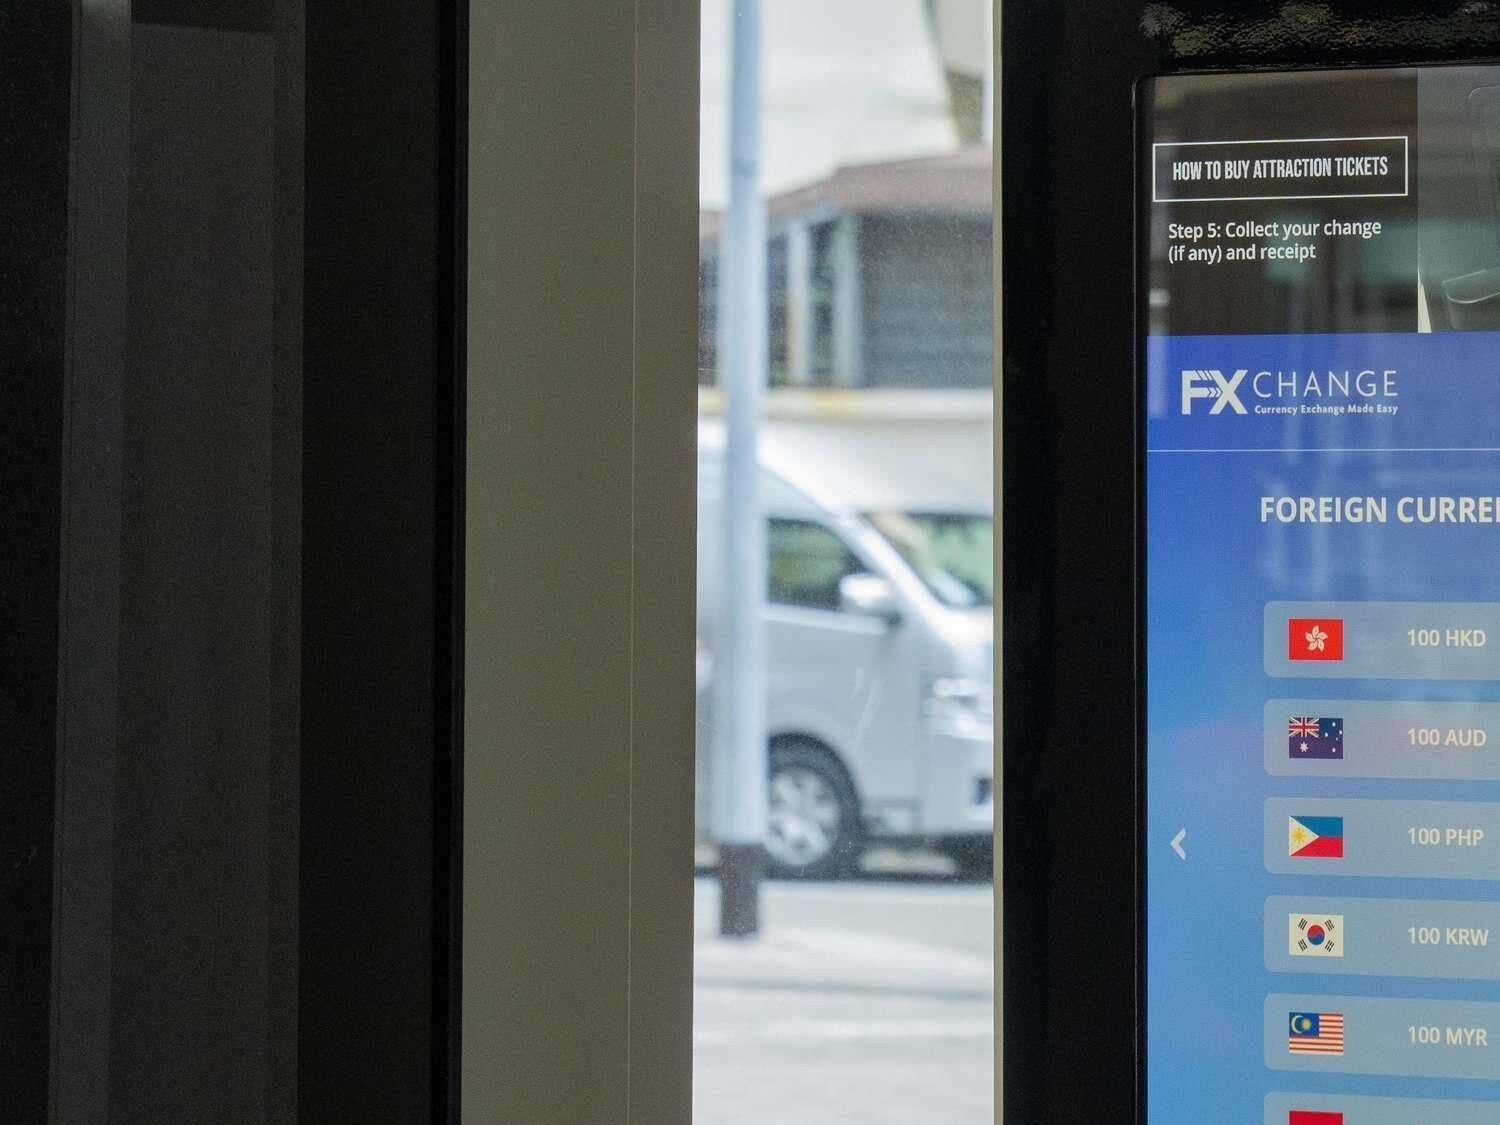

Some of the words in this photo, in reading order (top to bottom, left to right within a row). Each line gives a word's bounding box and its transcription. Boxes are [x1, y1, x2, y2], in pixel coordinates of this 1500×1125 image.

[1173, 161, 1202, 181] HOW
[1204, 160, 1222, 180] TO
[1224, 160, 1250, 179] BUY
[1253, 157, 1332, 179] ATTRACTION
[1334, 156, 1388, 176] TICKETS
[1168, 223, 1203, 243] Step
[1207, 222, 1221, 238] 5:
[1225, 221, 1279, 238] Collect
[1282, 223, 1320, 241] your
[1323, 219, 1382, 239] change
[1168, 245, 1185, 264] (if
[1188, 245, 1222, 265] any)
[1226, 243, 1256, 260] and
[1260, 243, 1316, 264] receipt
[1254, 404, 1298, 416] Currency
[1300, 404, 1345, 416] Exchange
[1347, 404, 1375, 414] Made
[1376, 404, 1398, 415] Easy
[1261, 496, 1387, 523] FOREIGN
[1408, 629, 1440, 647] 100
[1446, 629, 1486, 647] HKD
[1407, 728, 1440, 746] 100
[1444, 728, 1487, 746] AUD
[1408, 827, 1441, 845] 100
[1446, 828, 1484, 846] PHP
[1408, 927, 1441, 945] 100
[1446, 928, 1489, 946] KRW
[1408, 1026, 1441, 1044] 100
[1446, 1027, 1487, 1046] MYR
